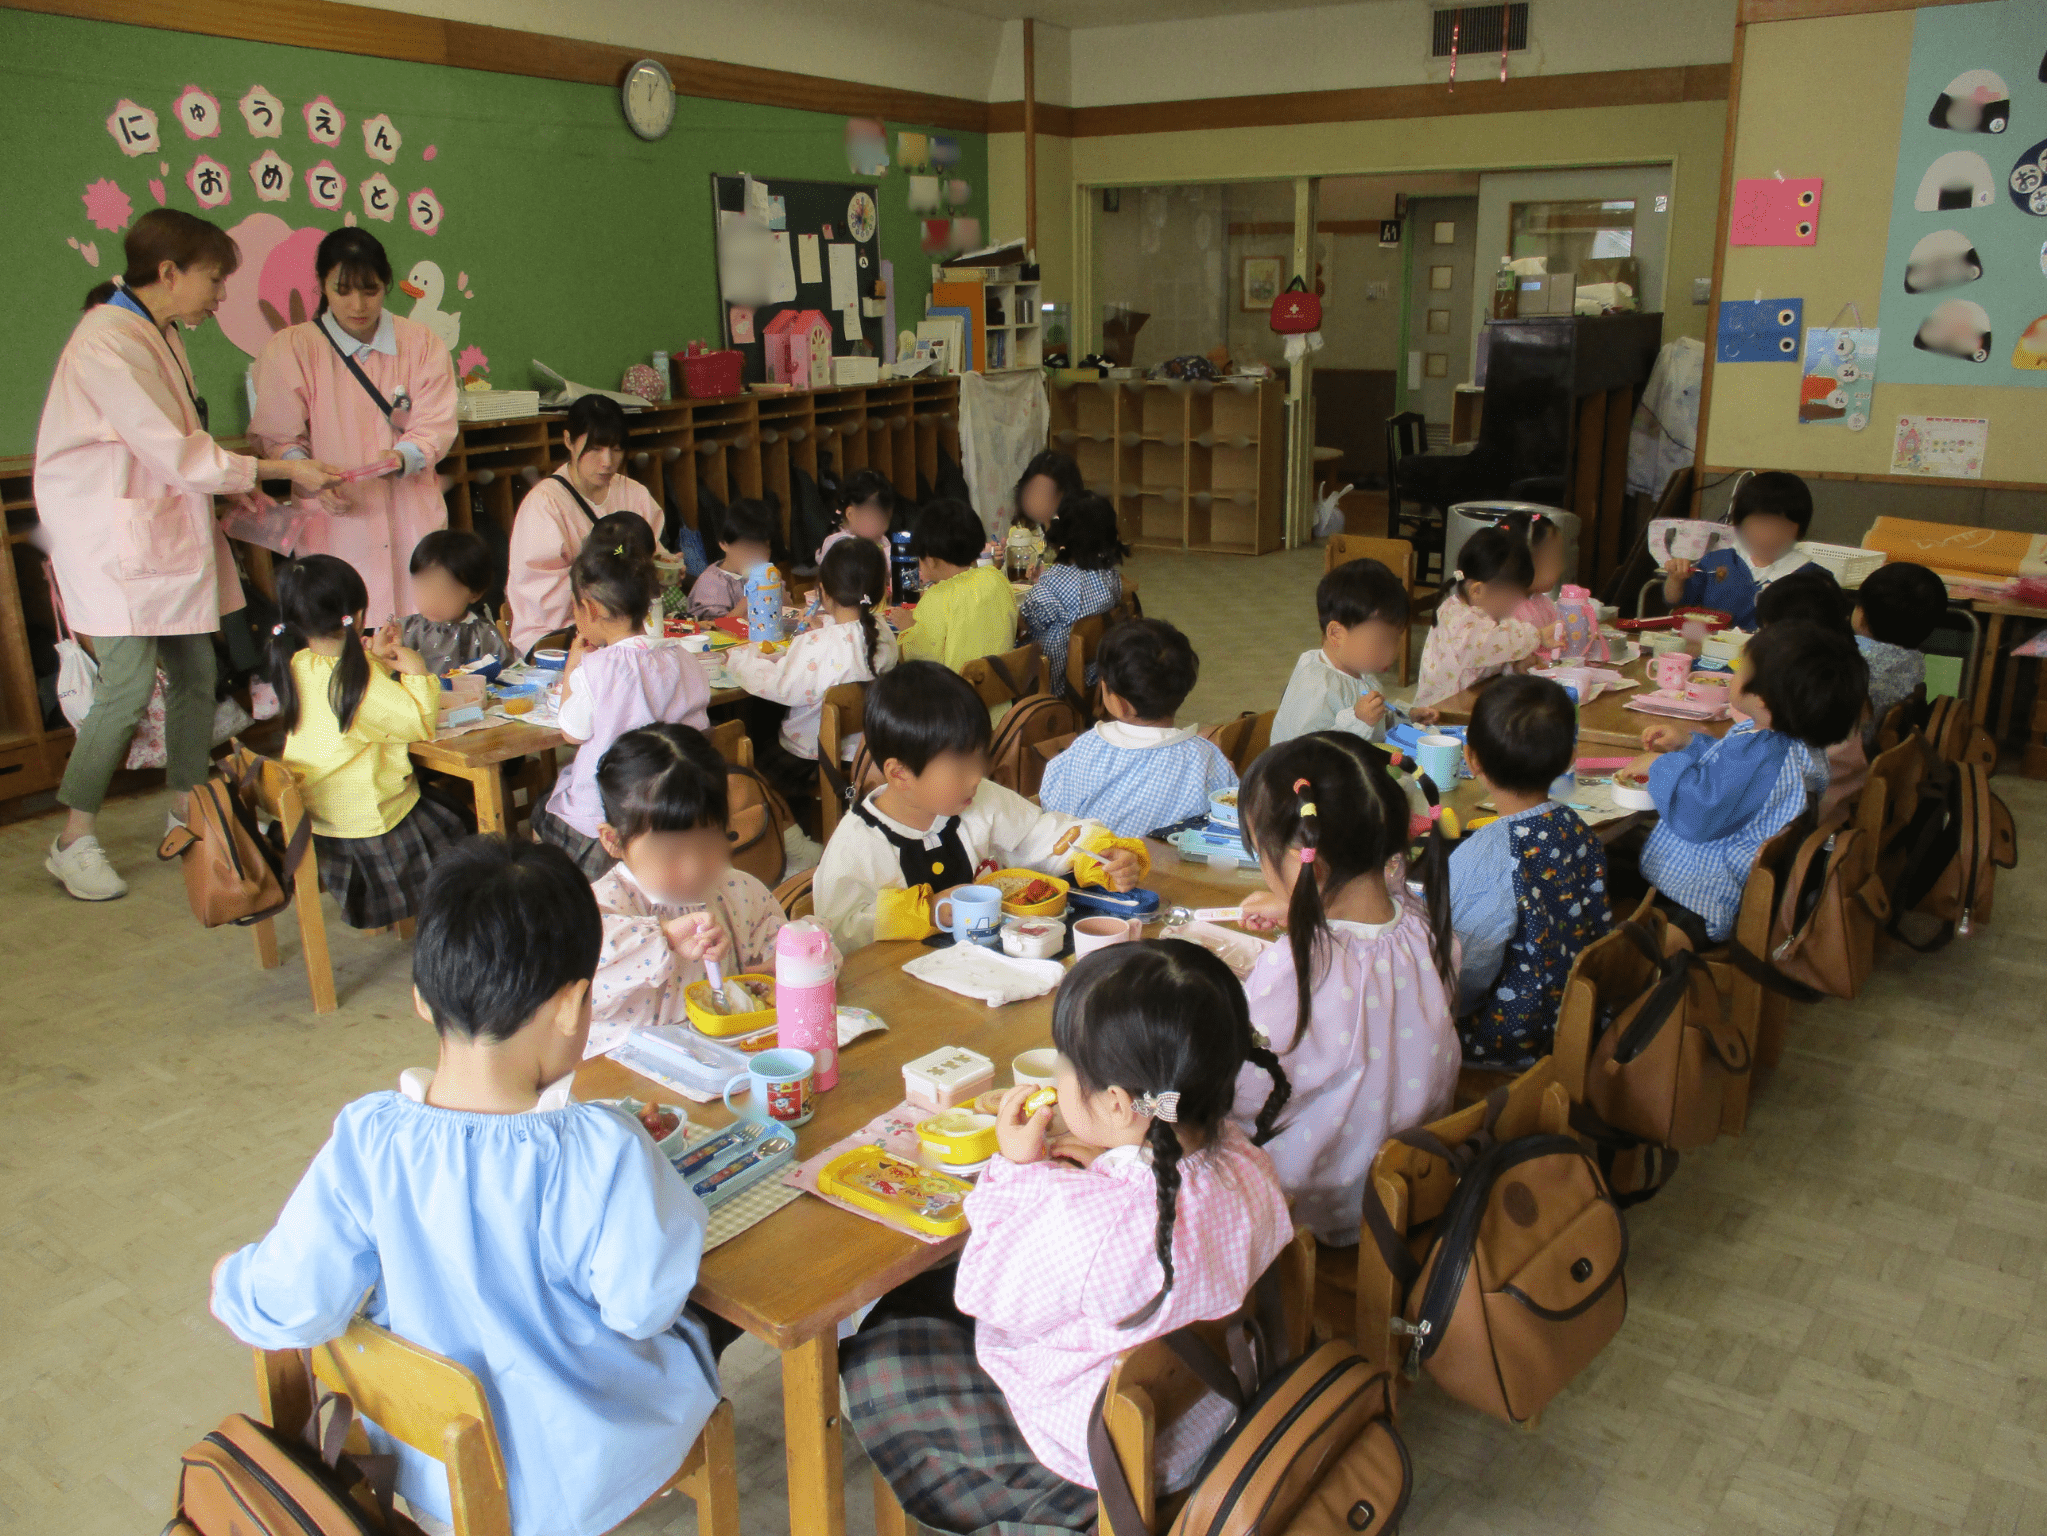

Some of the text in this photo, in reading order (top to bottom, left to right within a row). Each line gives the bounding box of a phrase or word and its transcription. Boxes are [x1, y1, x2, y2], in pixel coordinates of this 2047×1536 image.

[119, 100, 393, 152] にゅうえん
[198, 164, 434, 225] おめでとう
[1837, 342, 1845, 351] 4
[1843, 369, 1855, 378] 24
